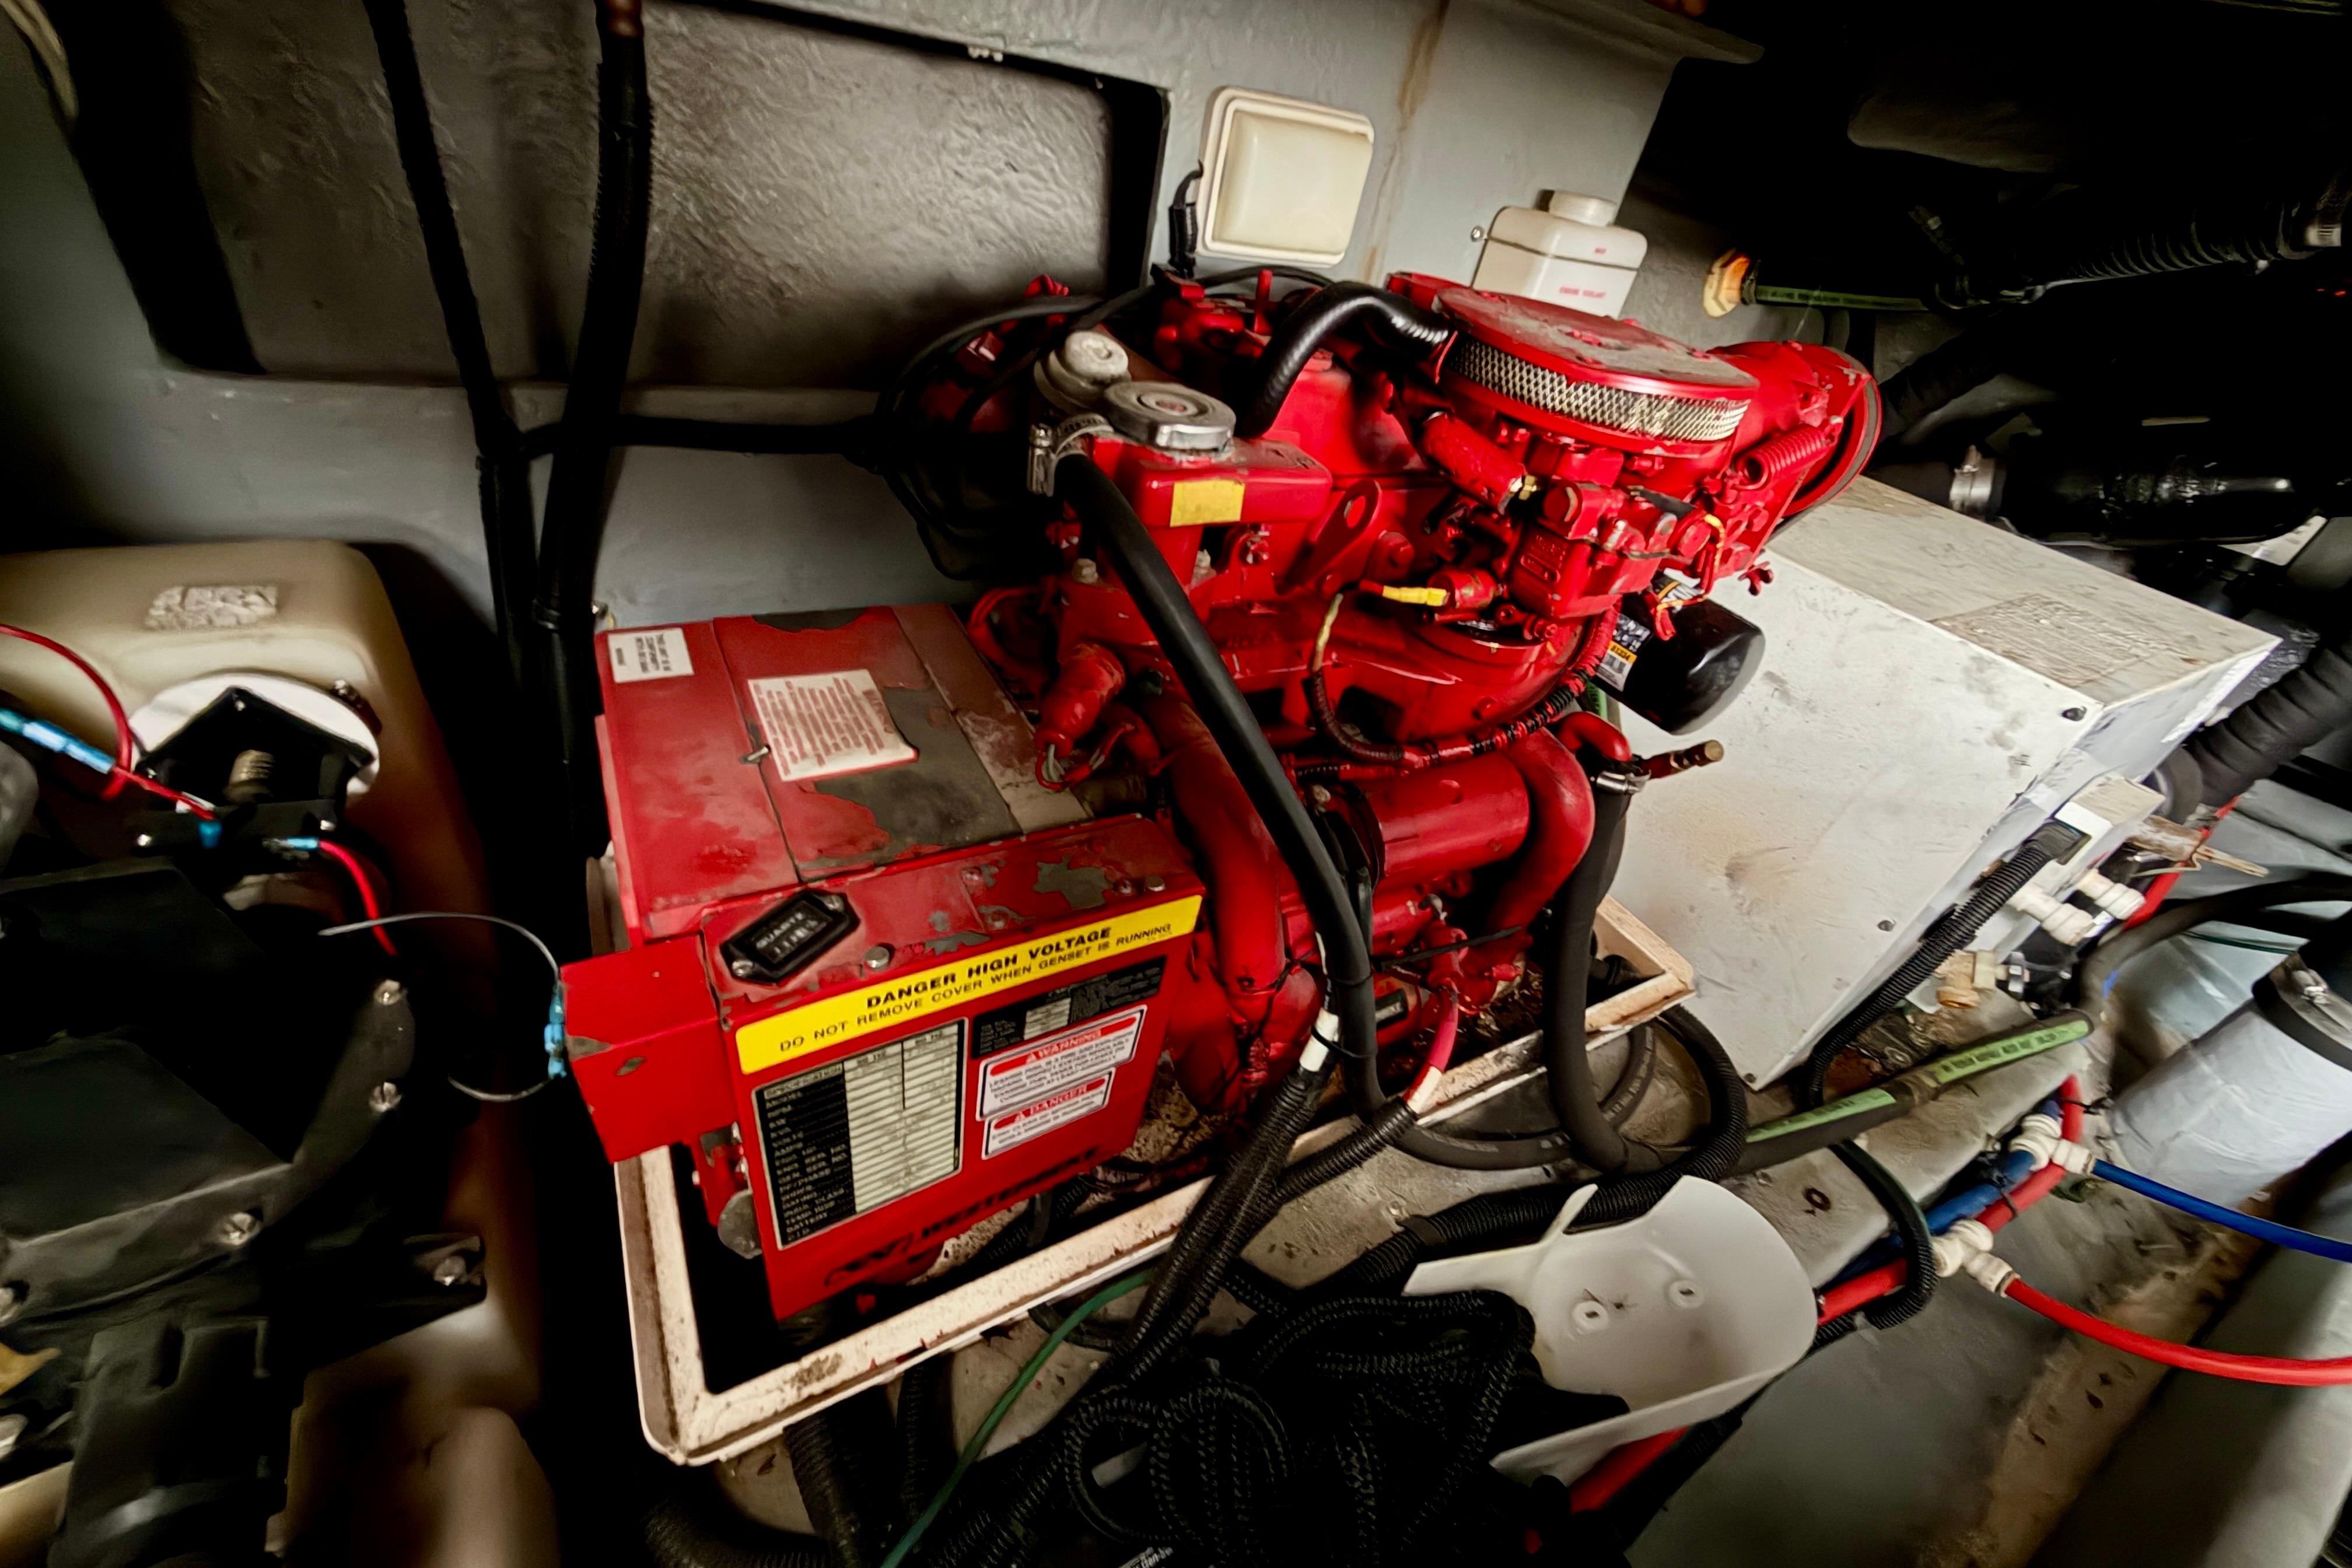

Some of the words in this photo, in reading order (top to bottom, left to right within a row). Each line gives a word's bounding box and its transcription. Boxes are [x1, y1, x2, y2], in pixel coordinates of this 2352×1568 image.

[780, 1035, 804, 1052] DO
[814, 1021, 848, 1040] NOT
[857, 998, 923, 1026] REMOVE
[932, 980, 982, 1003] COVER
[991, 964, 1031, 984] WHEN
[1039, 946, 1091, 970] GENSET
[1098, 941, 1110, 952] IS
[1116, 923, 1171, 947] RUNNING
[867, 973, 956, 1009] DANGER
[968, 954, 1018, 978] HIGH
[1028, 927, 1111, 960] VOLTAGE
[1038, 1029, 1102, 1060] WARNING
[1031, 1086, 1088, 1112] DANGER
